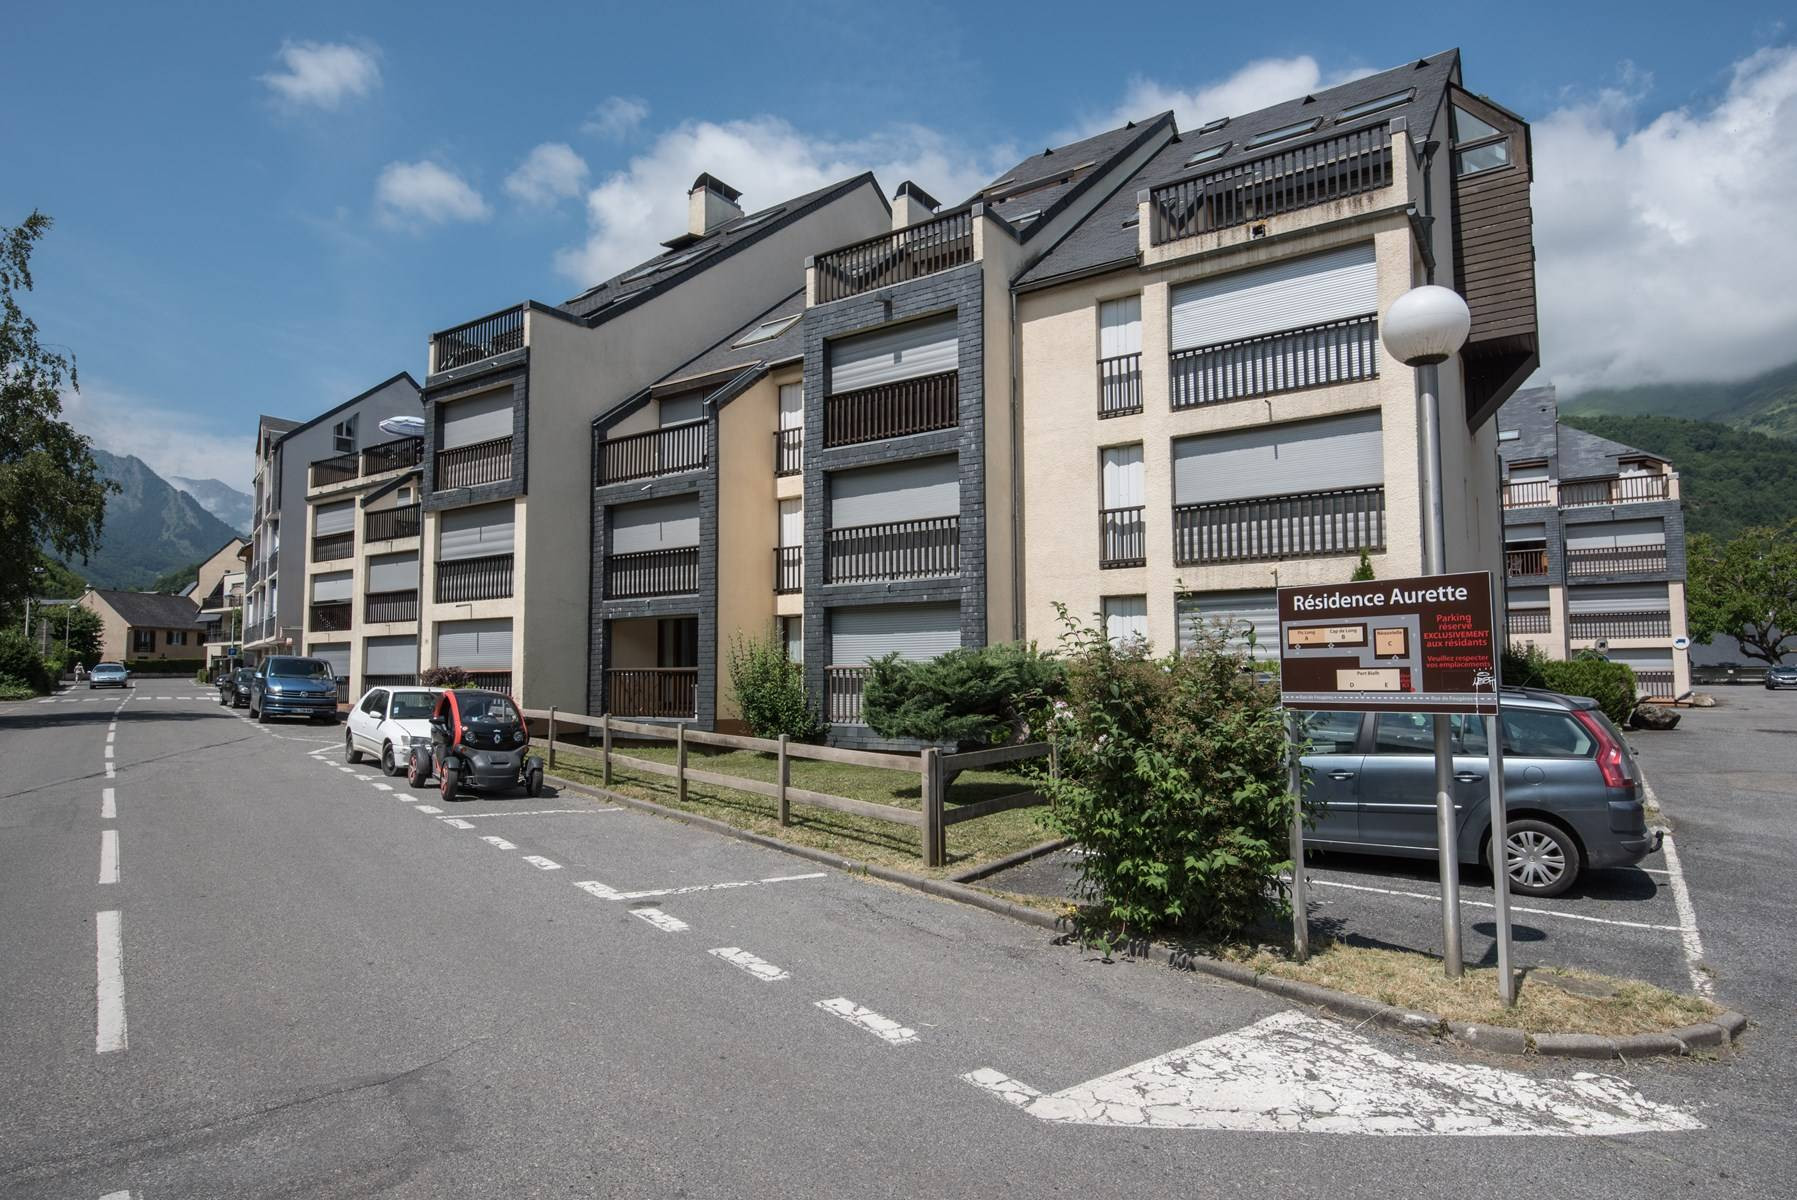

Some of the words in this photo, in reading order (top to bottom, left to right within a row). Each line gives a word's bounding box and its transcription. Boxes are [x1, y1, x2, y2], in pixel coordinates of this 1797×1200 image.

[1293, 592, 1385, 611] Résidence
[1390, 586, 1468, 605] Aurette
[1436, 614, 1472, 623] Parking
[1439, 622, 1473, 631] réservé
[1423, 630, 1489, 640] EXCLUSIVEMENT
[1445, 639, 1488, 647] résidants
